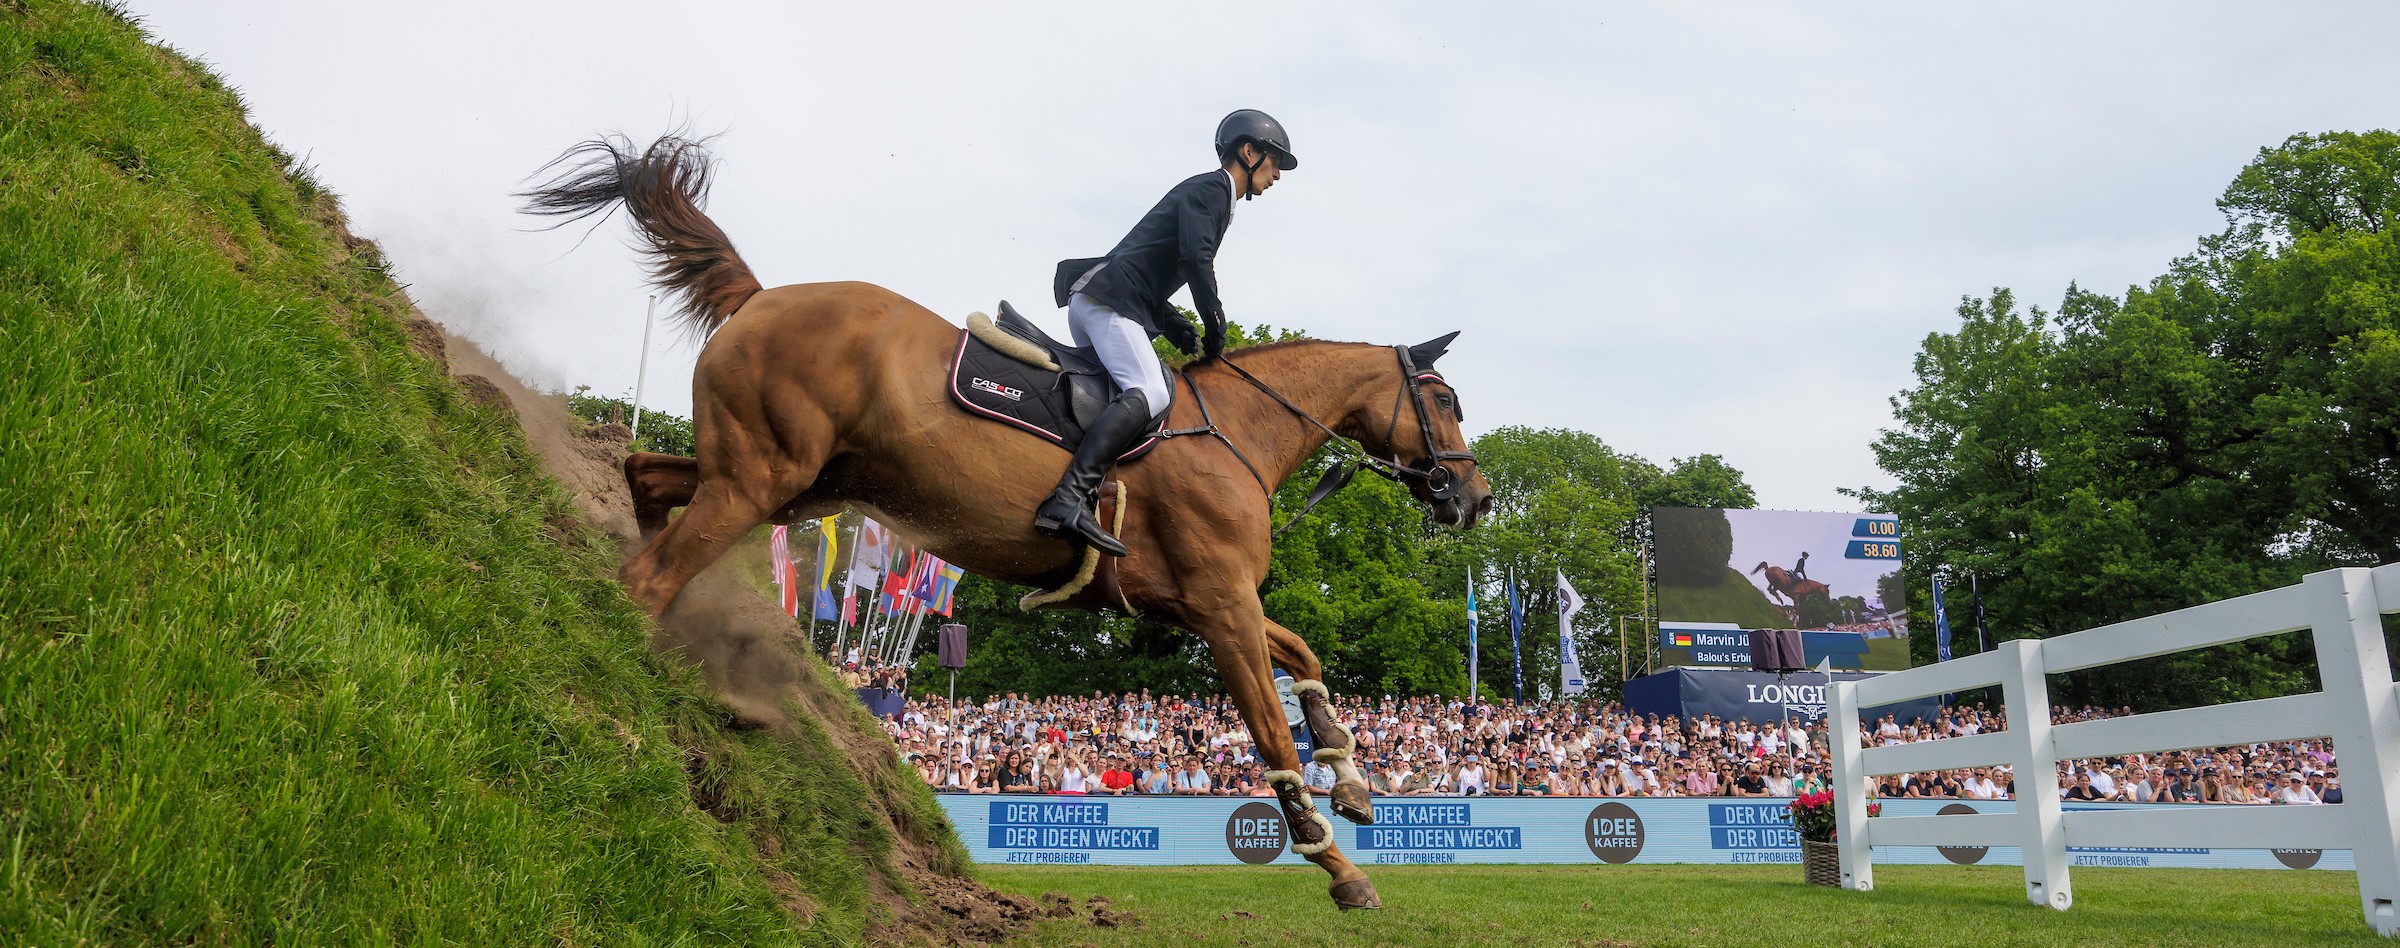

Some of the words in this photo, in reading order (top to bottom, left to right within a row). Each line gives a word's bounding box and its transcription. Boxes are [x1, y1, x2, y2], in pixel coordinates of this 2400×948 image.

[1869, 521, 1895, 535] 0.00
[1863, 543, 1897, 557] 58.60
[1696, 633, 1734, 646] Marvin
[1697, 652, 1729, 662] Balou's
[1007, 804, 1038, 823] DER
[1043, 804, 1107, 825] KAFFEE,
[1373, 806, 1403, 824] DER
[1408, 806, 1469, 825] KAFFEE,
[1725, 806, 1755, 824] DER
[1234, 818, 1280, 836] IDEE
[1592, 818, 1637, 836] IDEE
[1005, 828, 1037, 847] DER
[1043, 828, 1091, 847] IDEEN
[1095, 829, 1156, 848] WECKT.
[1235, 838, 1280, 849] KAFFEE
[1373, 829, 1404, 847] DER
[1409, 829, 1455, 848] IDEEN
[1459, 829, 1518, 848] WECKT.
[1594, 837, 1638, 848] KAFFEE
[1727, 829, 1758, 847] DER
[1006, 852, 1034, 862] JETZT
[1036, 852, 1090, 863] PROBIEREN!
[1375, 853, 1401, 863] JETZT
[1404, 853, 1455, 863] PROBIEREN!
[1731, 852, 1756, 862] JETZT
[2074, 856, 2099, 866] JETZT
[2101, 856, 2150, 867] PROBIEREN!
